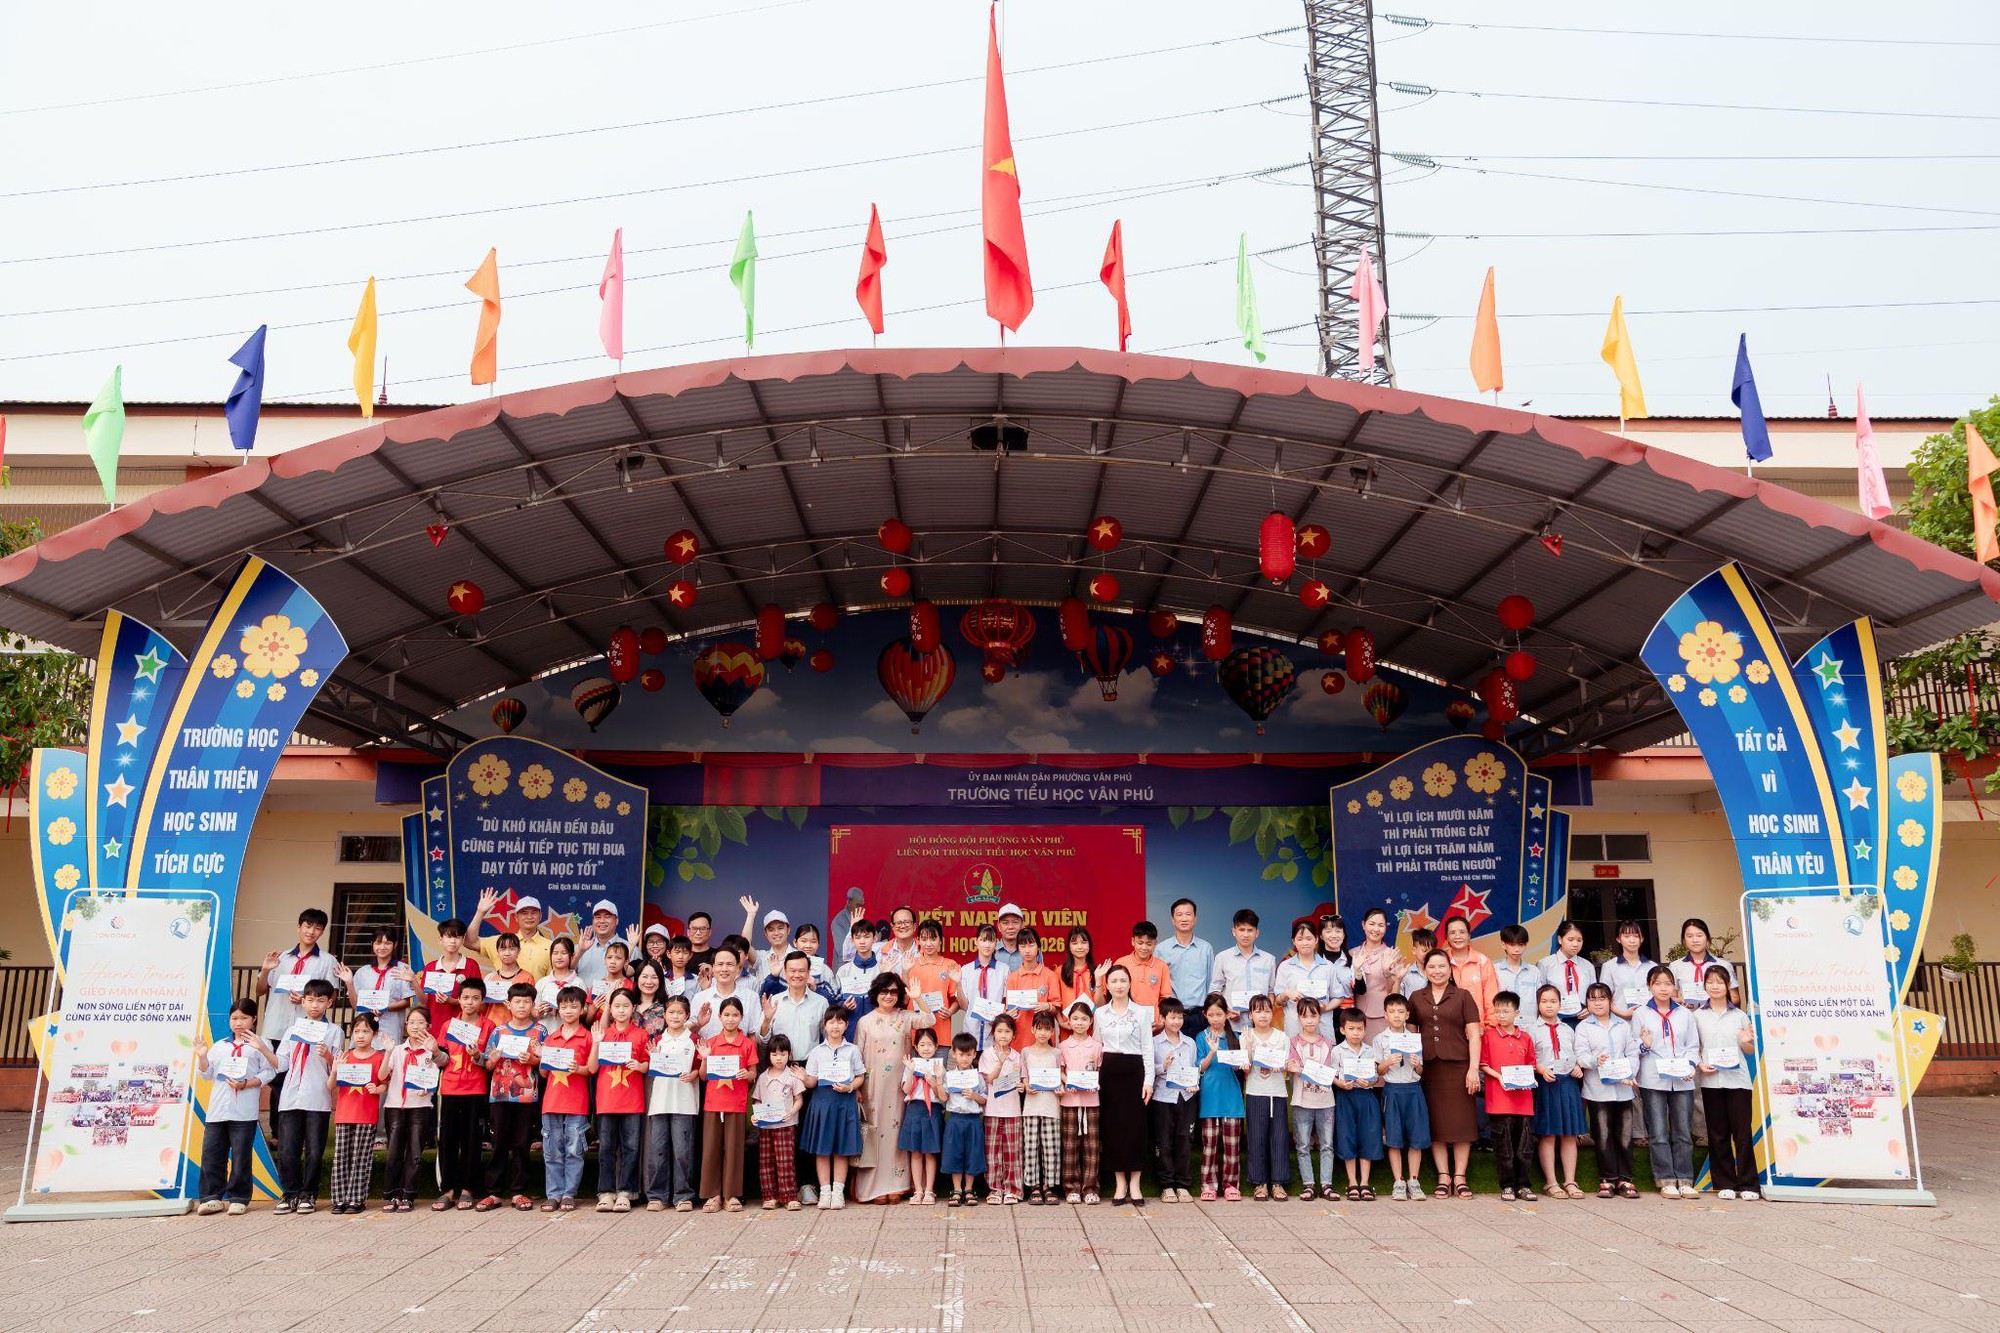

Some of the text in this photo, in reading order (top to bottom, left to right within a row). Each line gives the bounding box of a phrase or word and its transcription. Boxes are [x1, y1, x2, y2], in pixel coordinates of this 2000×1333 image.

[183, 724, 279, 752] TRƯỜNG HỌC
[1736, 727, 1787, 751] TẤT CẢ
[169, 766, 259, 793] THÂN THIỆN
[968, 770, 981, 781] ỦY
[1004, 772, 1029, 781] NHÂN
[1053, 772, 1091, 782] PHƯỜNG
[1093, 772, 1112, 781] VÂN
[1114, 771, 1132, 781] PHÚ
[1762, 770, 1777, 793] VÌ
[948, 783, 1154, 803] TRƯỜNG TIỂU HỌC VÂN PHÚ
[163, 812, 237, 835] HỌC SINH
[1397, 811, 1413, 824] LỢI
[1416, 810, 1434, 822] ÍCH
[1437, 808, 1465, 821] MƯỜI
[1468, 808, 1494, 820] NĂM
[502, 818, 526, 832] KHÓ
[529, 818, 561, 834] KHĂN
[564, 817, 587, 834] ĐẾN
[591, 820, 614, 835] ĐÂU
[1383, 826, 1400, 839] THÌ
[1403, 825, 1428, 839] PHẢI
[1469, 824, 1490, 837] CÂY
[1749, 815, 1819, 837] HỌC SINH
[461, 837, 625, 857] CŨNG PHẢI TIẾP TỤC THI ĐUA
[909, 835, 927, 845] HỘI
[959, 835, 976, 845] ĐỘI
[979, 835, 1019, 844] PHƯỜNG
[1044, 835, 1064, 844] PHÚ
[1381, 841, 1494, 857] VÌ LỢI ÍCH TRĂM NĂM
[897, 846, 920, 857] LIÊN
[943, 847, 982, 857] TRƯỜNG
[1010, 848, 1032, 858] HỌC
[154, 849, 225, 877] TÍCH CỰC
[481, 861, 505, 877] DẠY
[508, 858, 529, 875] TỐT
[532, 860, 547, 875] VÀ
[550, 863, 574, 878] HỌC
[1376, 860, 1393, 873] THÌ
[1396, 858, 1421, 872] PHẢI
[1752, 852, 1825, 875] THÂN YÊU
[1042, 907, 1087, 927] VIÊN
[77, 1002, 97, 1011] NON
[99, 1001, 124, 1011] SÔNG
[148, 1001, 167, 1012] MỘT
[1774, 999, 1792, 1007] NON
[1794, 998, 1817, 1007] SÔNG
[65, 1012, 91, 1022] CÙNG
[93, 1012, 112, 1022] XÂY
[113, 1012, 139, 1023] CUỘC
[166, 1014, 192, 1022] XANH
[1766, 1008, 1790, 1018] CÙNG
[1791, 1008, 1808, 1017] XÂY
[1810, 1008, 1833, 1020] CUỘC
[1860, 1009, 1885, 1018] XANH
